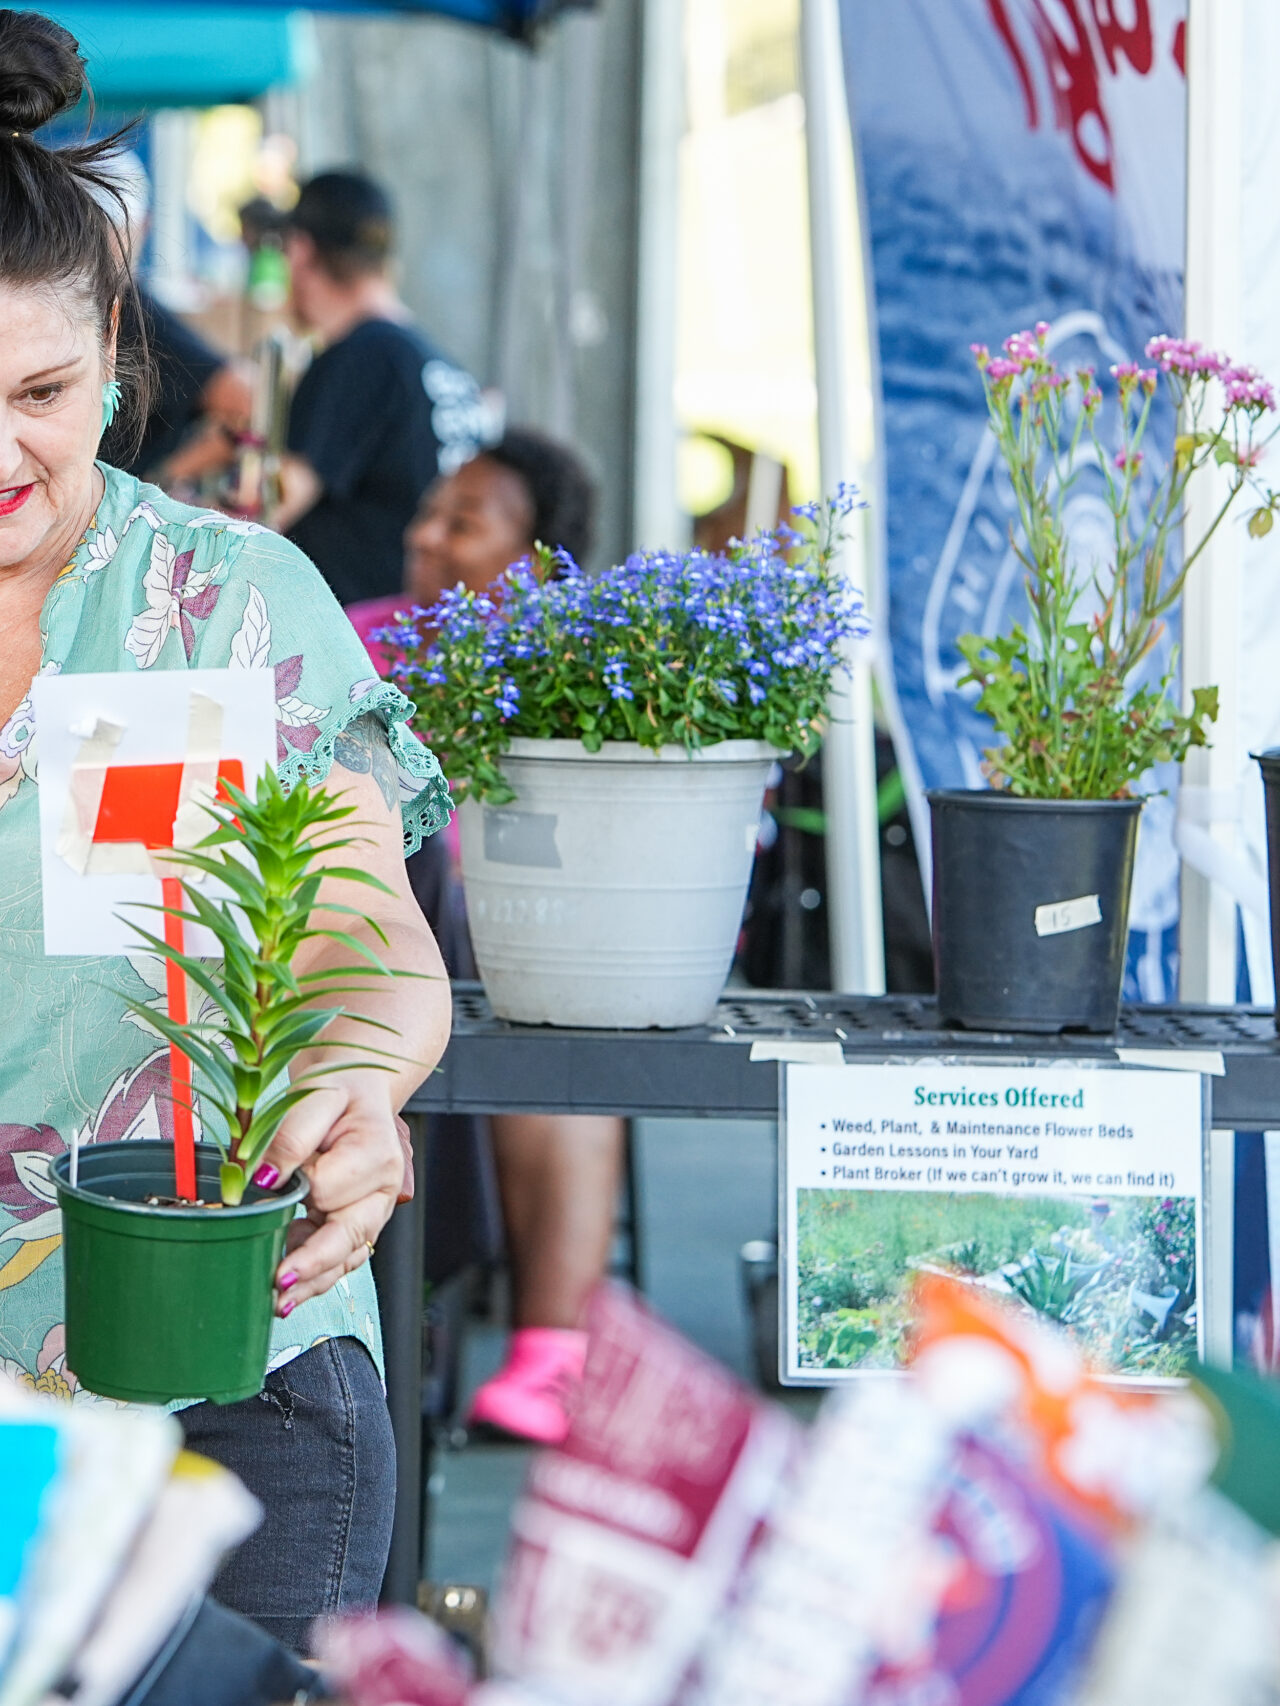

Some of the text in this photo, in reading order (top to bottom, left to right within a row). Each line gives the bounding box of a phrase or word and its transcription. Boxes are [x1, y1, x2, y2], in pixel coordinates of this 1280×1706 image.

[913, 1086, 1084, 1109] Services Offered
[832, 1119, 1134, 1139] Weed, Plant, & Maintenance Flower Beds
[832, 1142, 1039, 1160] Garden Lessons in Your Yard
[832, 1166, 1175, 1189] Plant Broker (If we can't grow it, we can find it)
